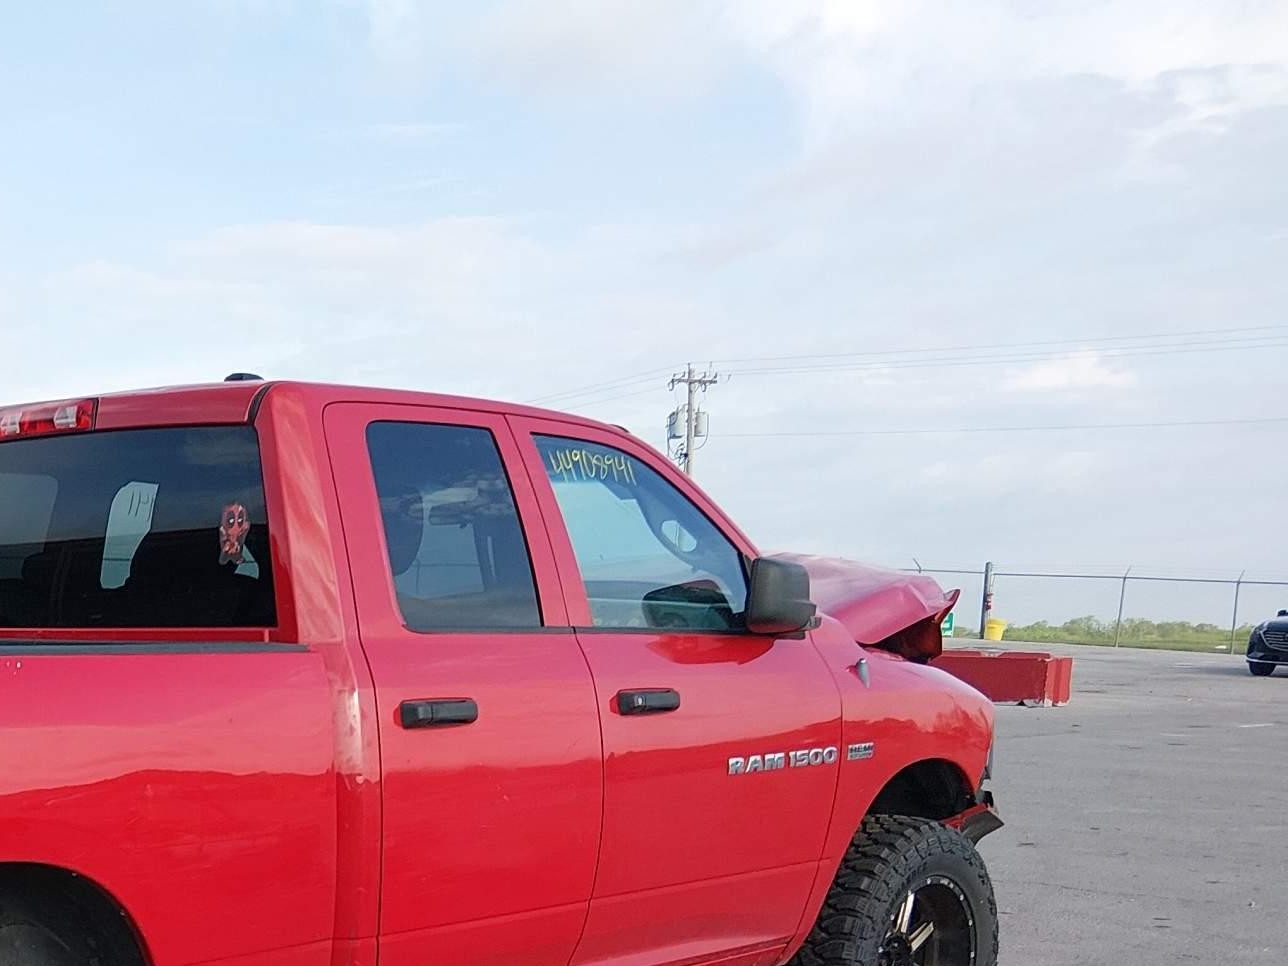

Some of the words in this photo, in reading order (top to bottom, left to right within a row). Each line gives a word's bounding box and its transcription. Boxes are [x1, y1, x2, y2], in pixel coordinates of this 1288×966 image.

[548, 449, 637, 486] 44908941
[728, 752, 785, 775] RAM
[789, 746, 837, 768] 1500
